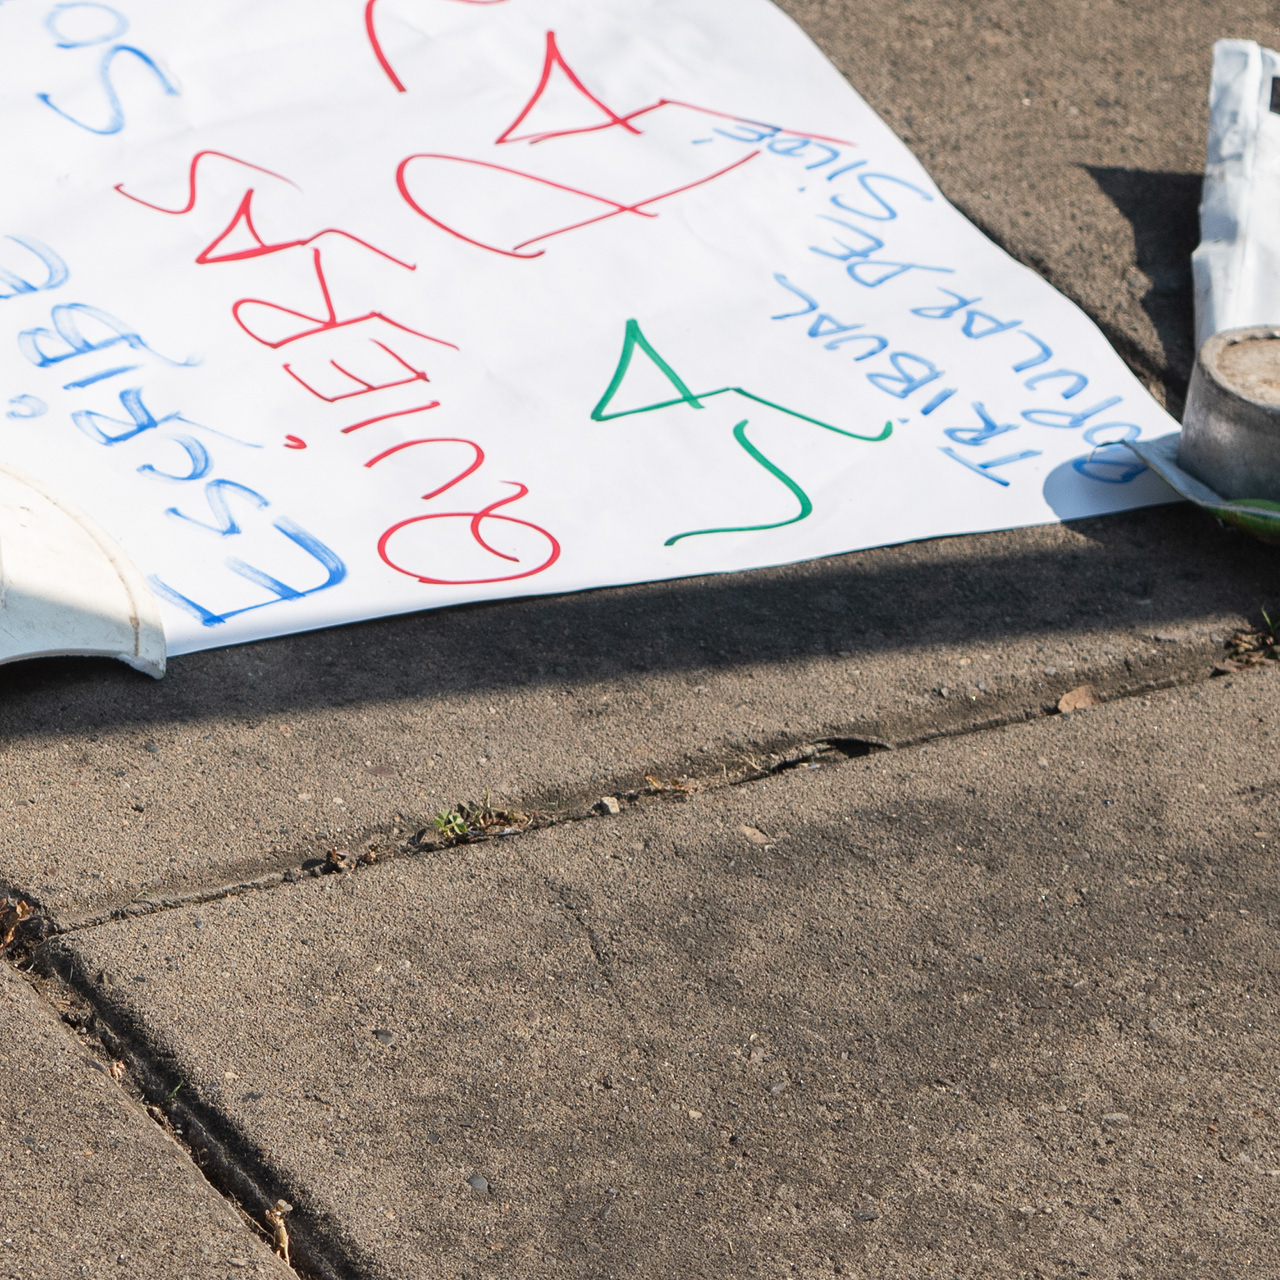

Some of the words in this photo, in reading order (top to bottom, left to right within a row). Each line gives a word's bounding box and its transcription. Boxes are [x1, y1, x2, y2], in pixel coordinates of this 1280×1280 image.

[806, 211, 957, 288] DE
[113, 149, 563, 586] QUIERAS
[588, 317, 895, 548] LA
